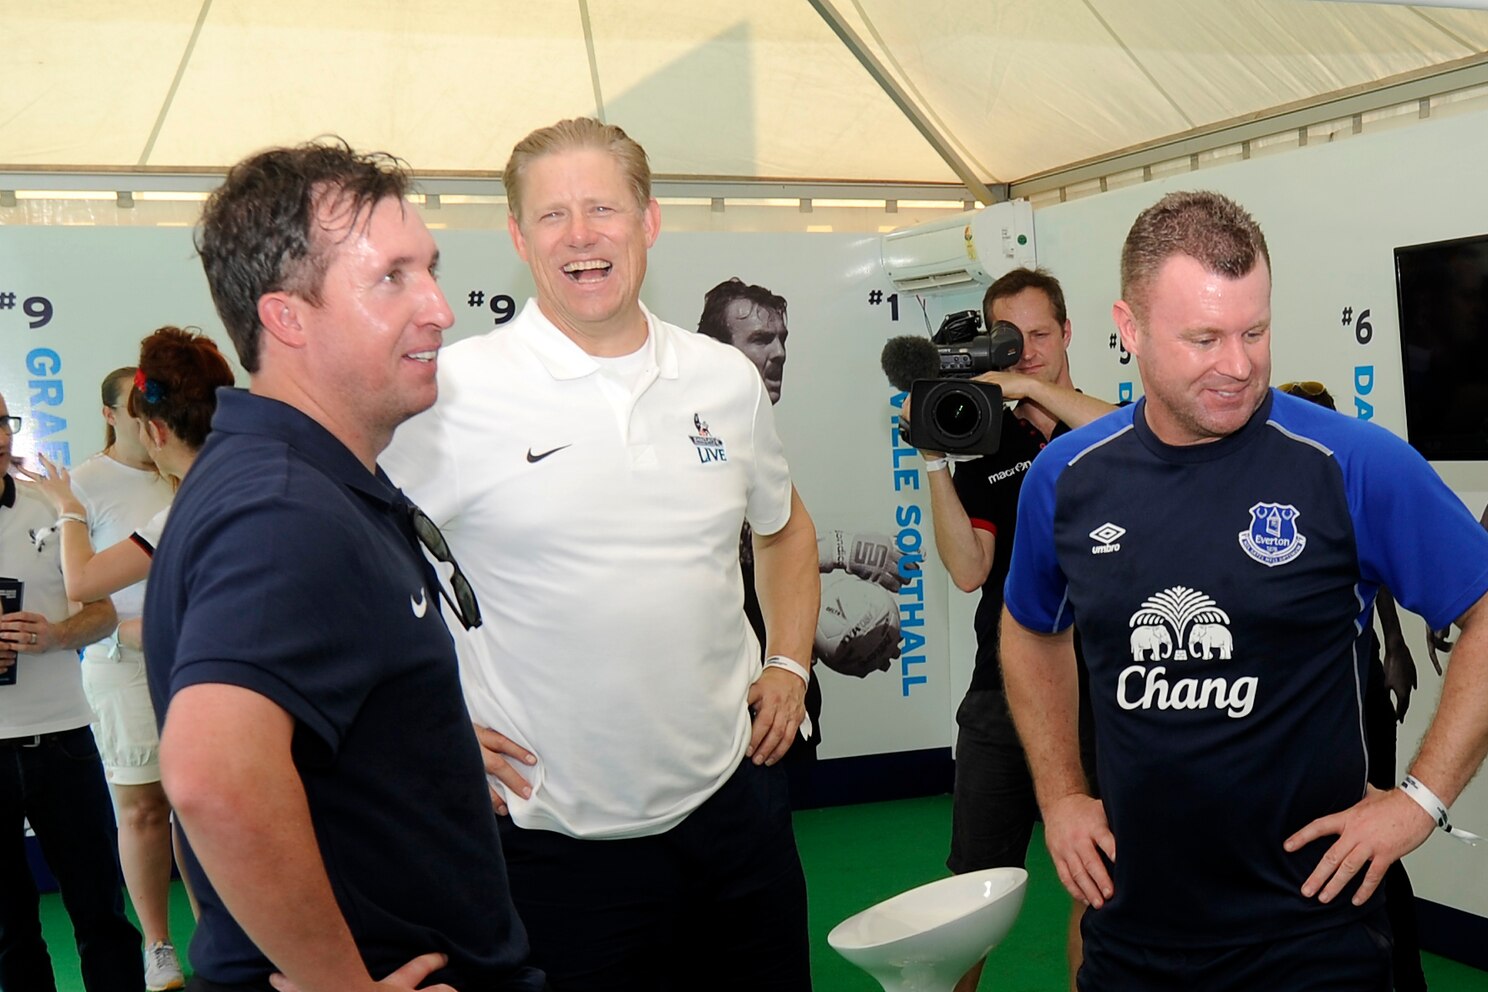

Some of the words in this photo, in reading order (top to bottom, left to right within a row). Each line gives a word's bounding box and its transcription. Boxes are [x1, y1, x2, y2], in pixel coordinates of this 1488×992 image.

[0, 292, 54, 329] #9
[468, 291, 516, 325] #9
[868, 290, 899, 321] #1
[1342, 307, 1373, 345] #6
[697, 446, 727, 463] LIVE
[988, 460, 1032, 484] macron
[1092, 543, 1120, 554] umbro
[1255, 534, 1290, 547] Everton
[896, 505, 928, 697] SOUTHALL
[1116, 665, 1259, 718] Chang
